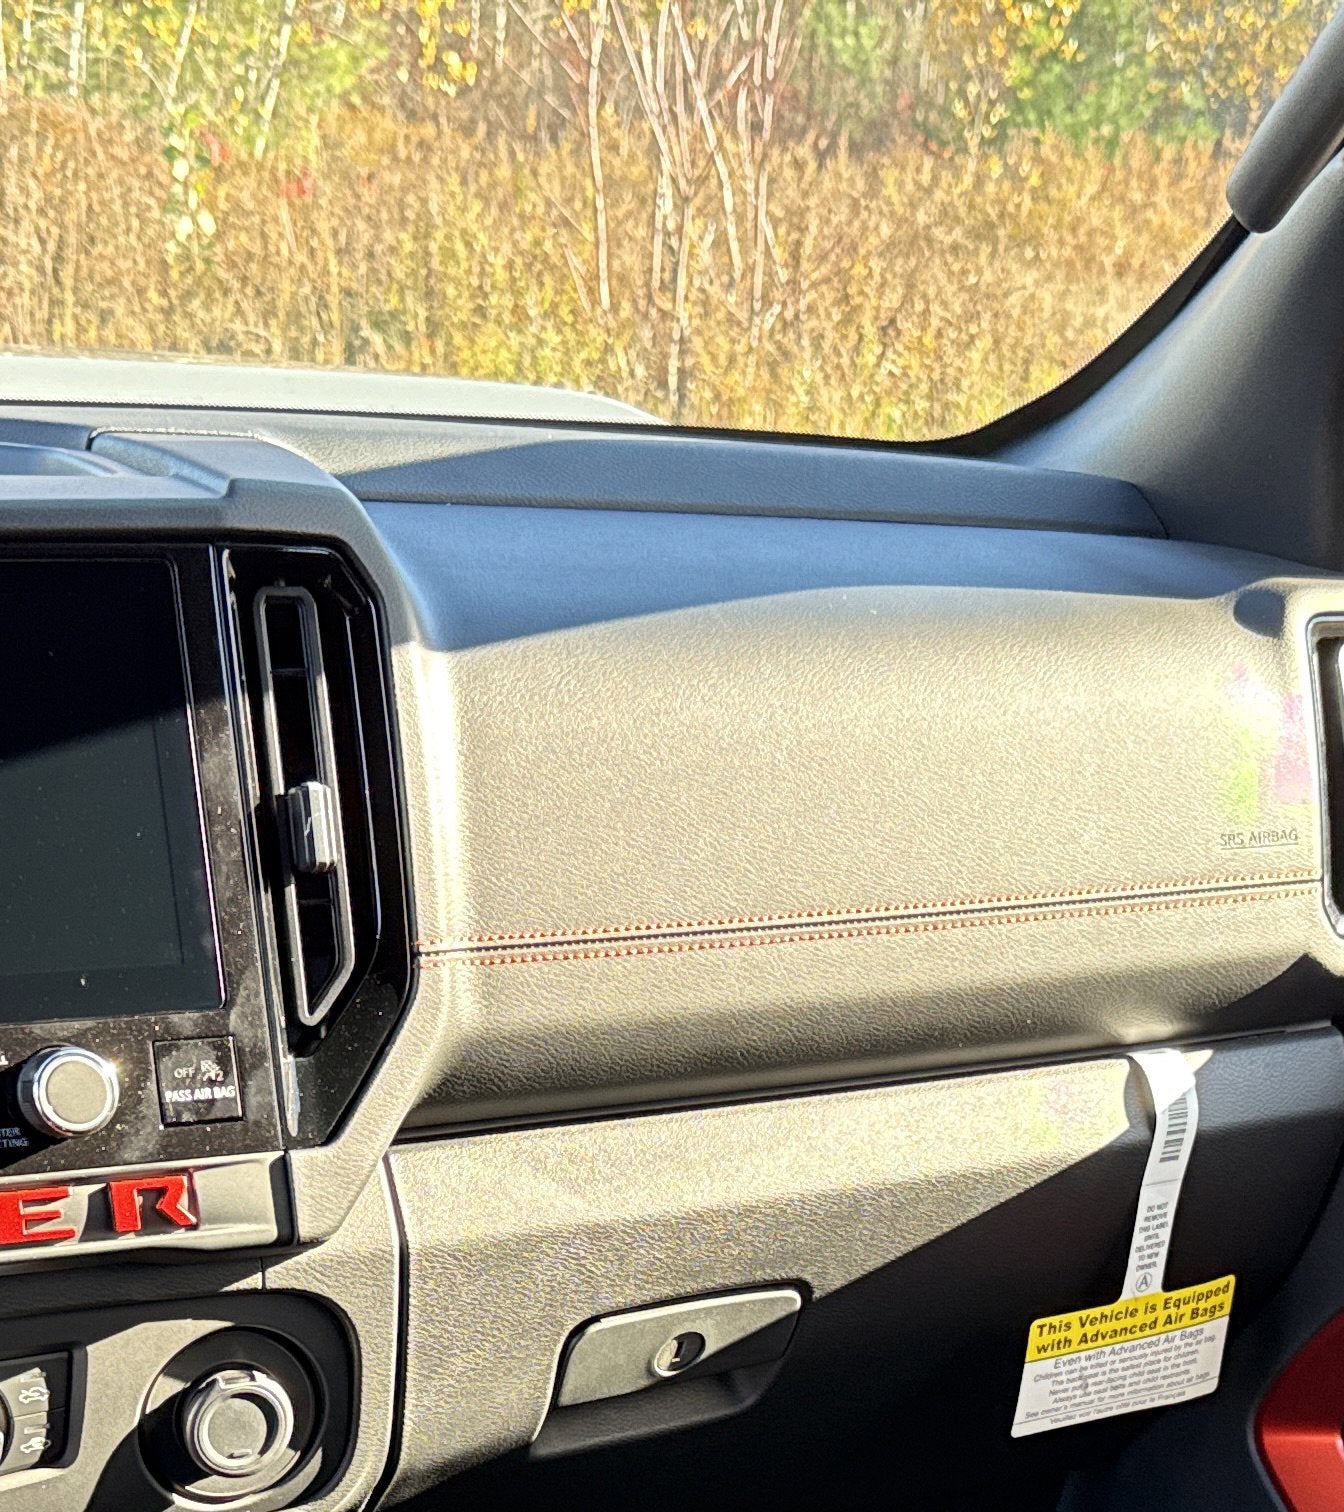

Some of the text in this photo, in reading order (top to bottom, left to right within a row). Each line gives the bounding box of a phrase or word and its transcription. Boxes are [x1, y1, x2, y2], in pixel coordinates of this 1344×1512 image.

[1219, 828, 1298, 846] SRS AIRBAG
[174, 1067, 195, 1079] OFF
[164, 1085, 235, 1103] PASS AIR BAG
[1036, 1280, 1230, 1338] This Vehicle is Equipped
[1036, 1300, 1225, 1354] with Advanced Air Bags
[1054, 1328, 1204, 1370] Even with Advanced Air Bags
